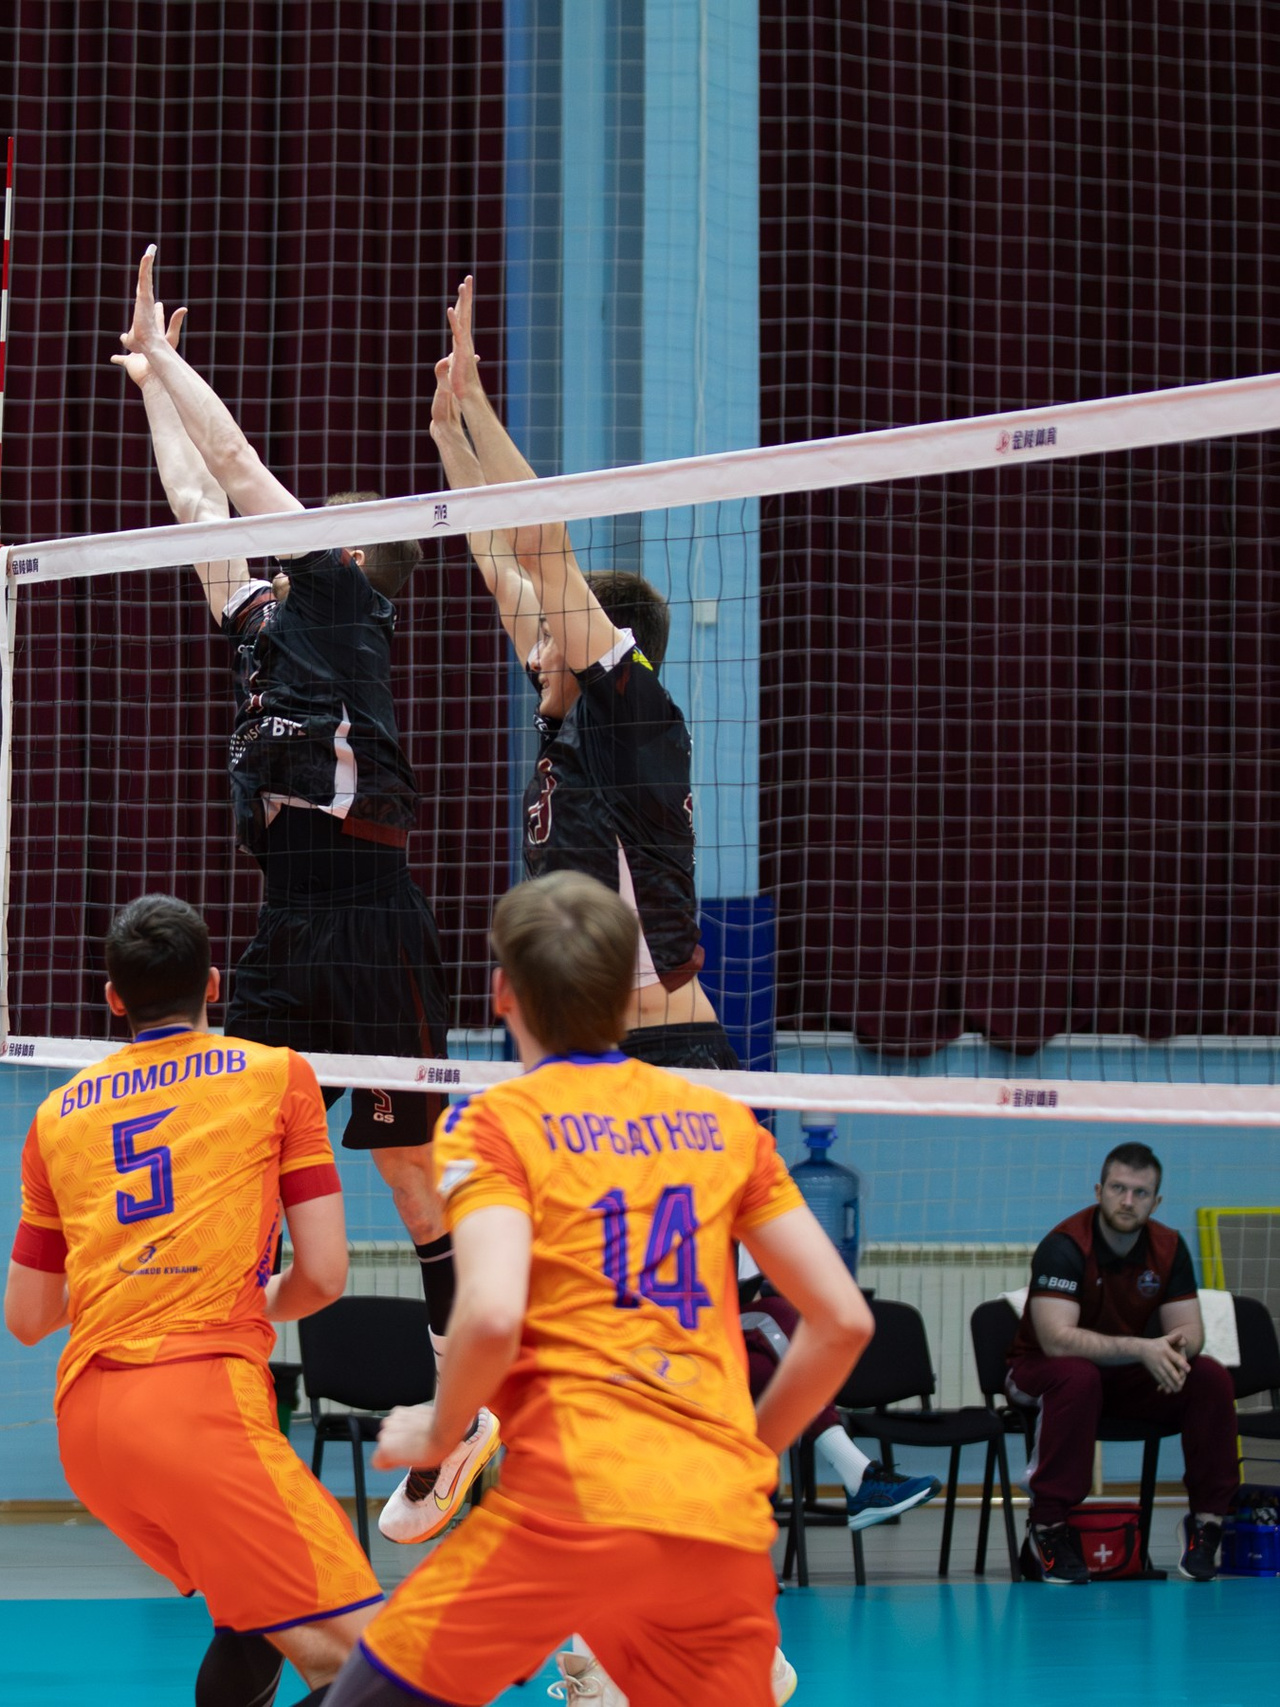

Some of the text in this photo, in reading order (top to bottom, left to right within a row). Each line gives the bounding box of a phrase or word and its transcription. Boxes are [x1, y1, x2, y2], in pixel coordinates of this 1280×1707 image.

[60, 1049, 247, 1118] БОГОМОЛОВ
[112, 1105, 180, 1225] 5
[588, 1183, 714, 1330] 14
[1048, 1276, 1078, 1291] ВФВ
